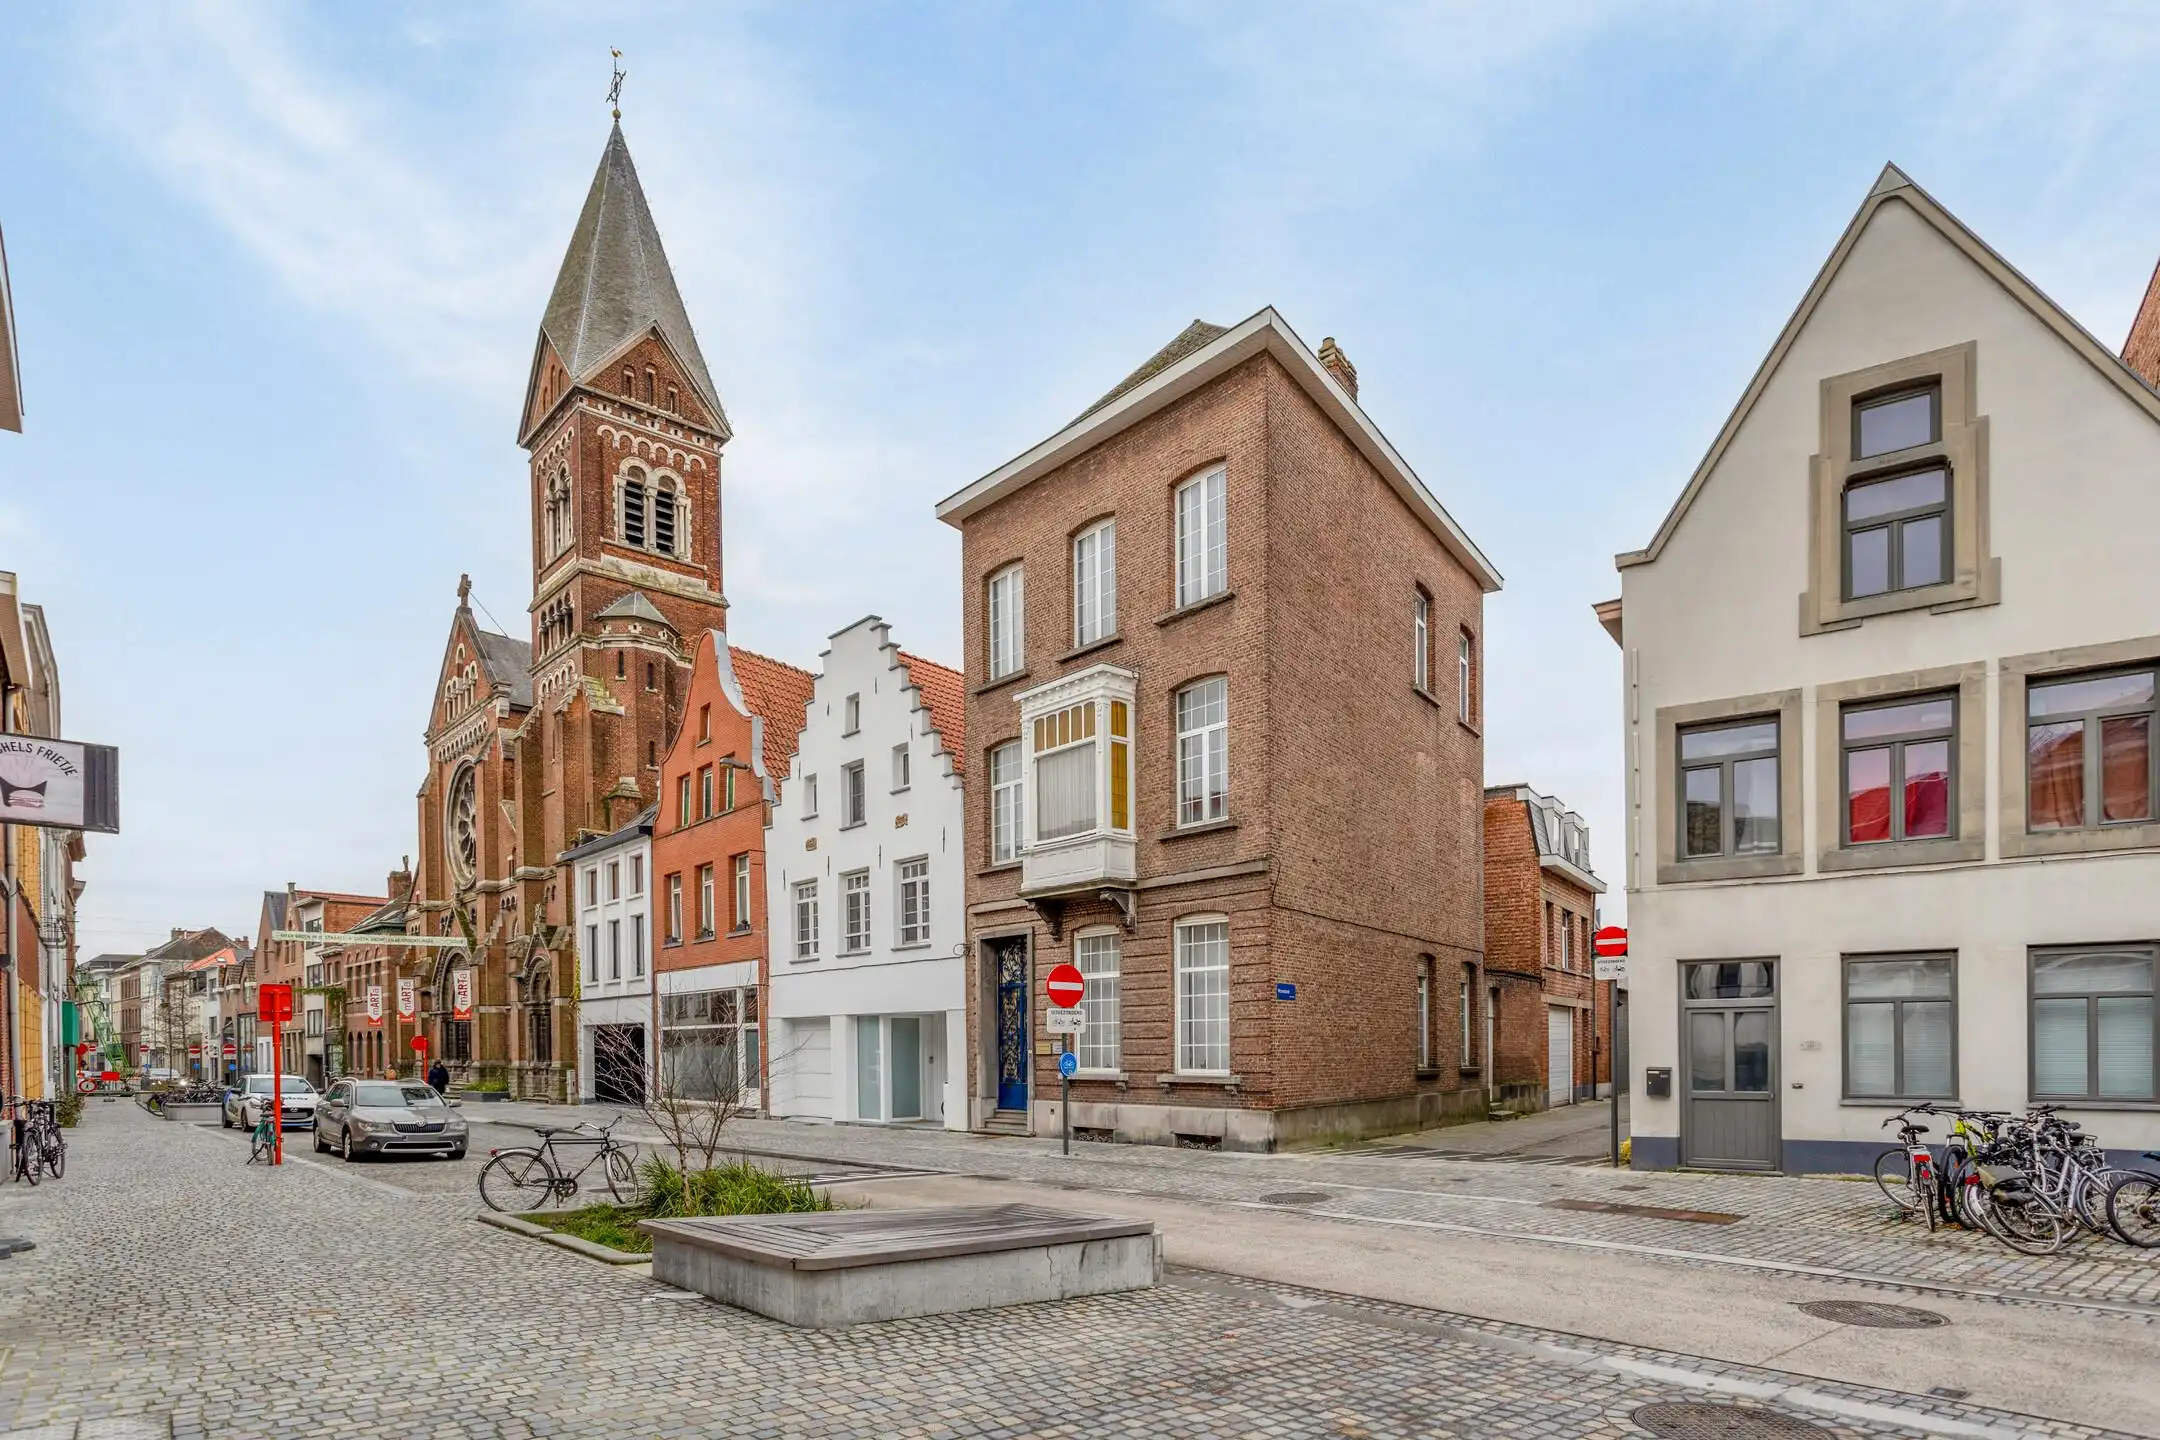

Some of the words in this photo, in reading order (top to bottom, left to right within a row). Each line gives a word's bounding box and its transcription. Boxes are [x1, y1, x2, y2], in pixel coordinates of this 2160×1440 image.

[36, 746, 78, 776] FRIETJE
[370, 987, 380, 1016] mARTa
[401, 981, 412, 1010] mARTa
[457, 973, 469, 1005] mARTa
